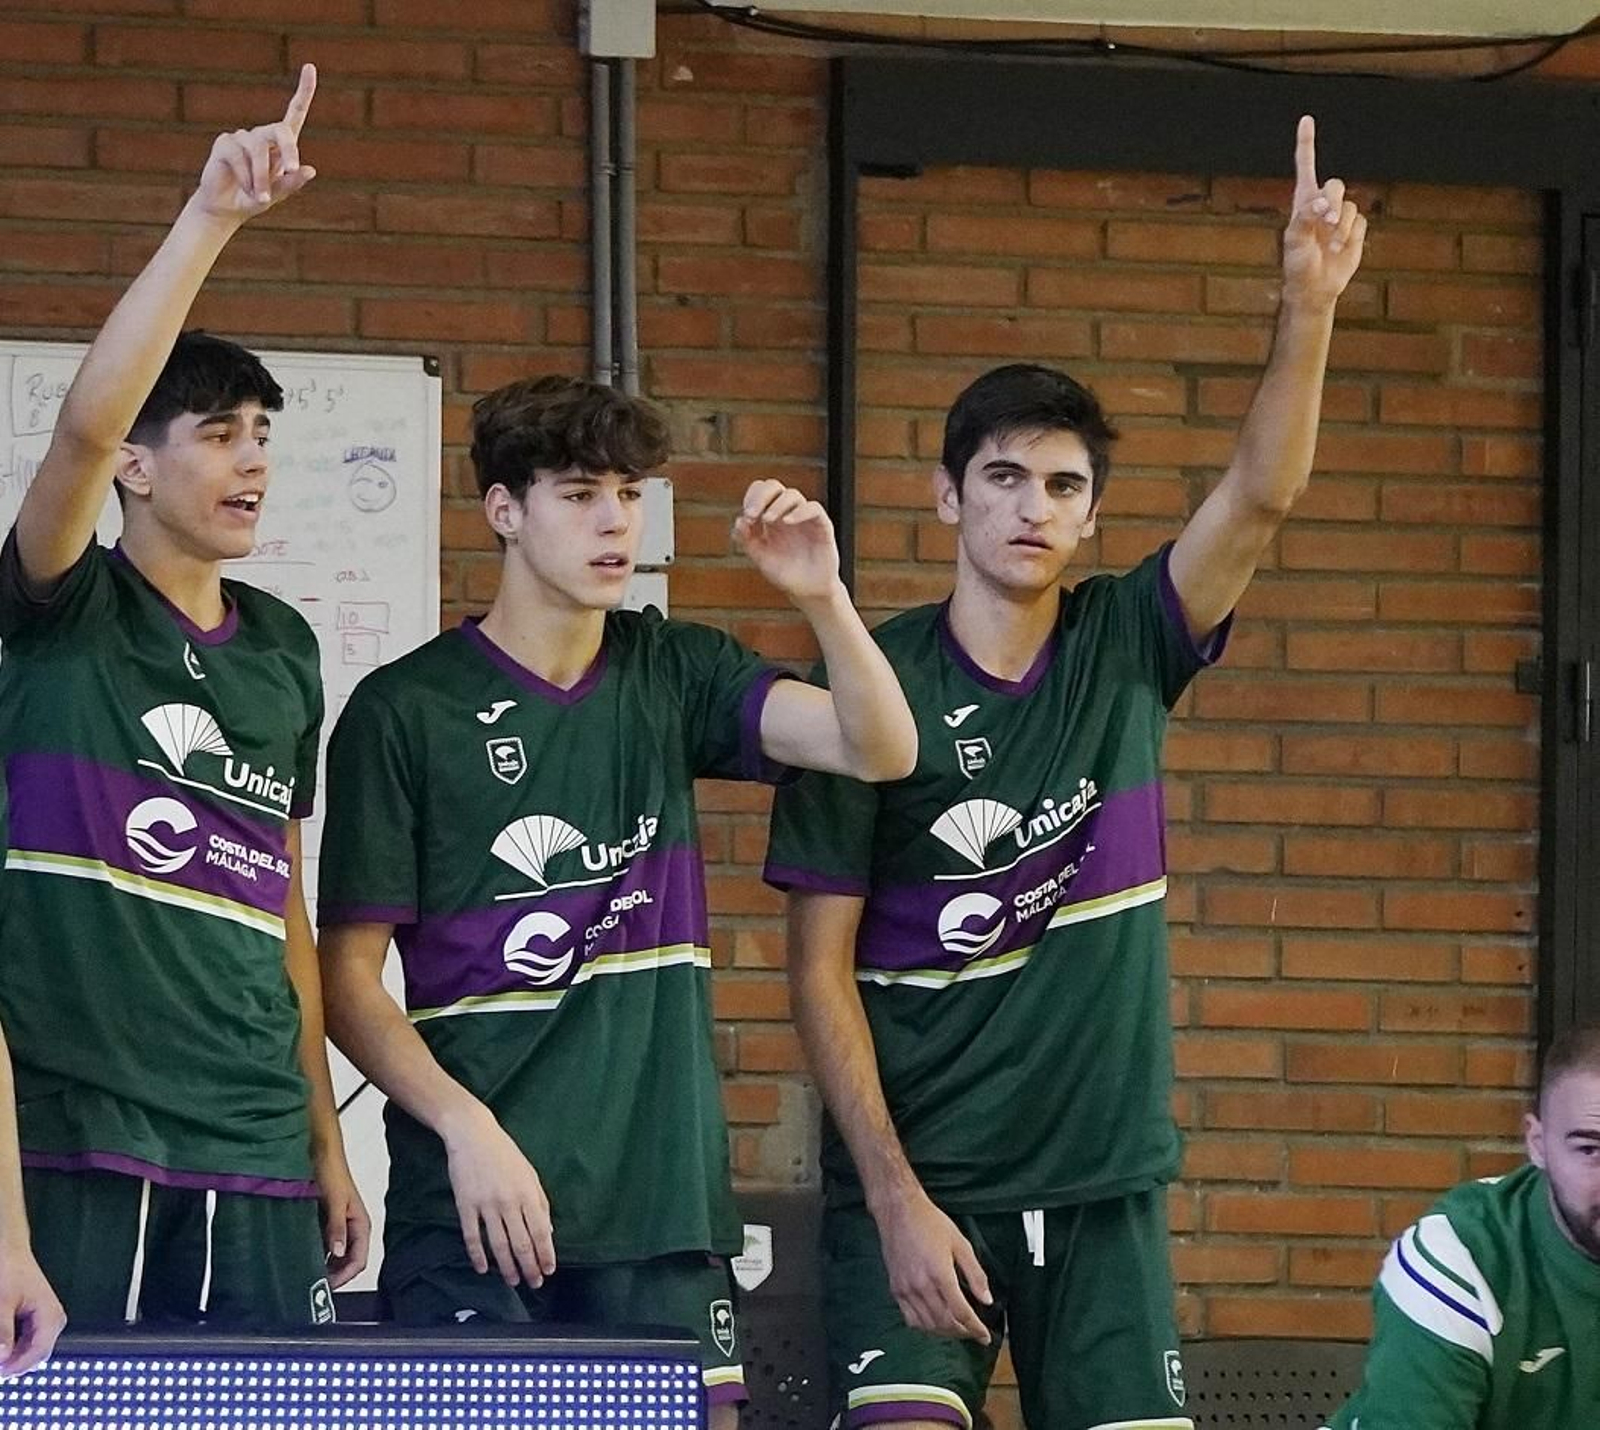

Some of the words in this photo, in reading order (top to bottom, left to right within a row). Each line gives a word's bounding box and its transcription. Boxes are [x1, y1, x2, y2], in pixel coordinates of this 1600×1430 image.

[224, 757, 295, 814] Unicaj
[1014, 777, 1098, 849] Unicaja
[205, 850, 257, 881] MÁLAGA
[208, 834, 248, 861] COSTA
[248, 849, 275, 871] DEL
[1014, 878, 1058, 907] COSTA
